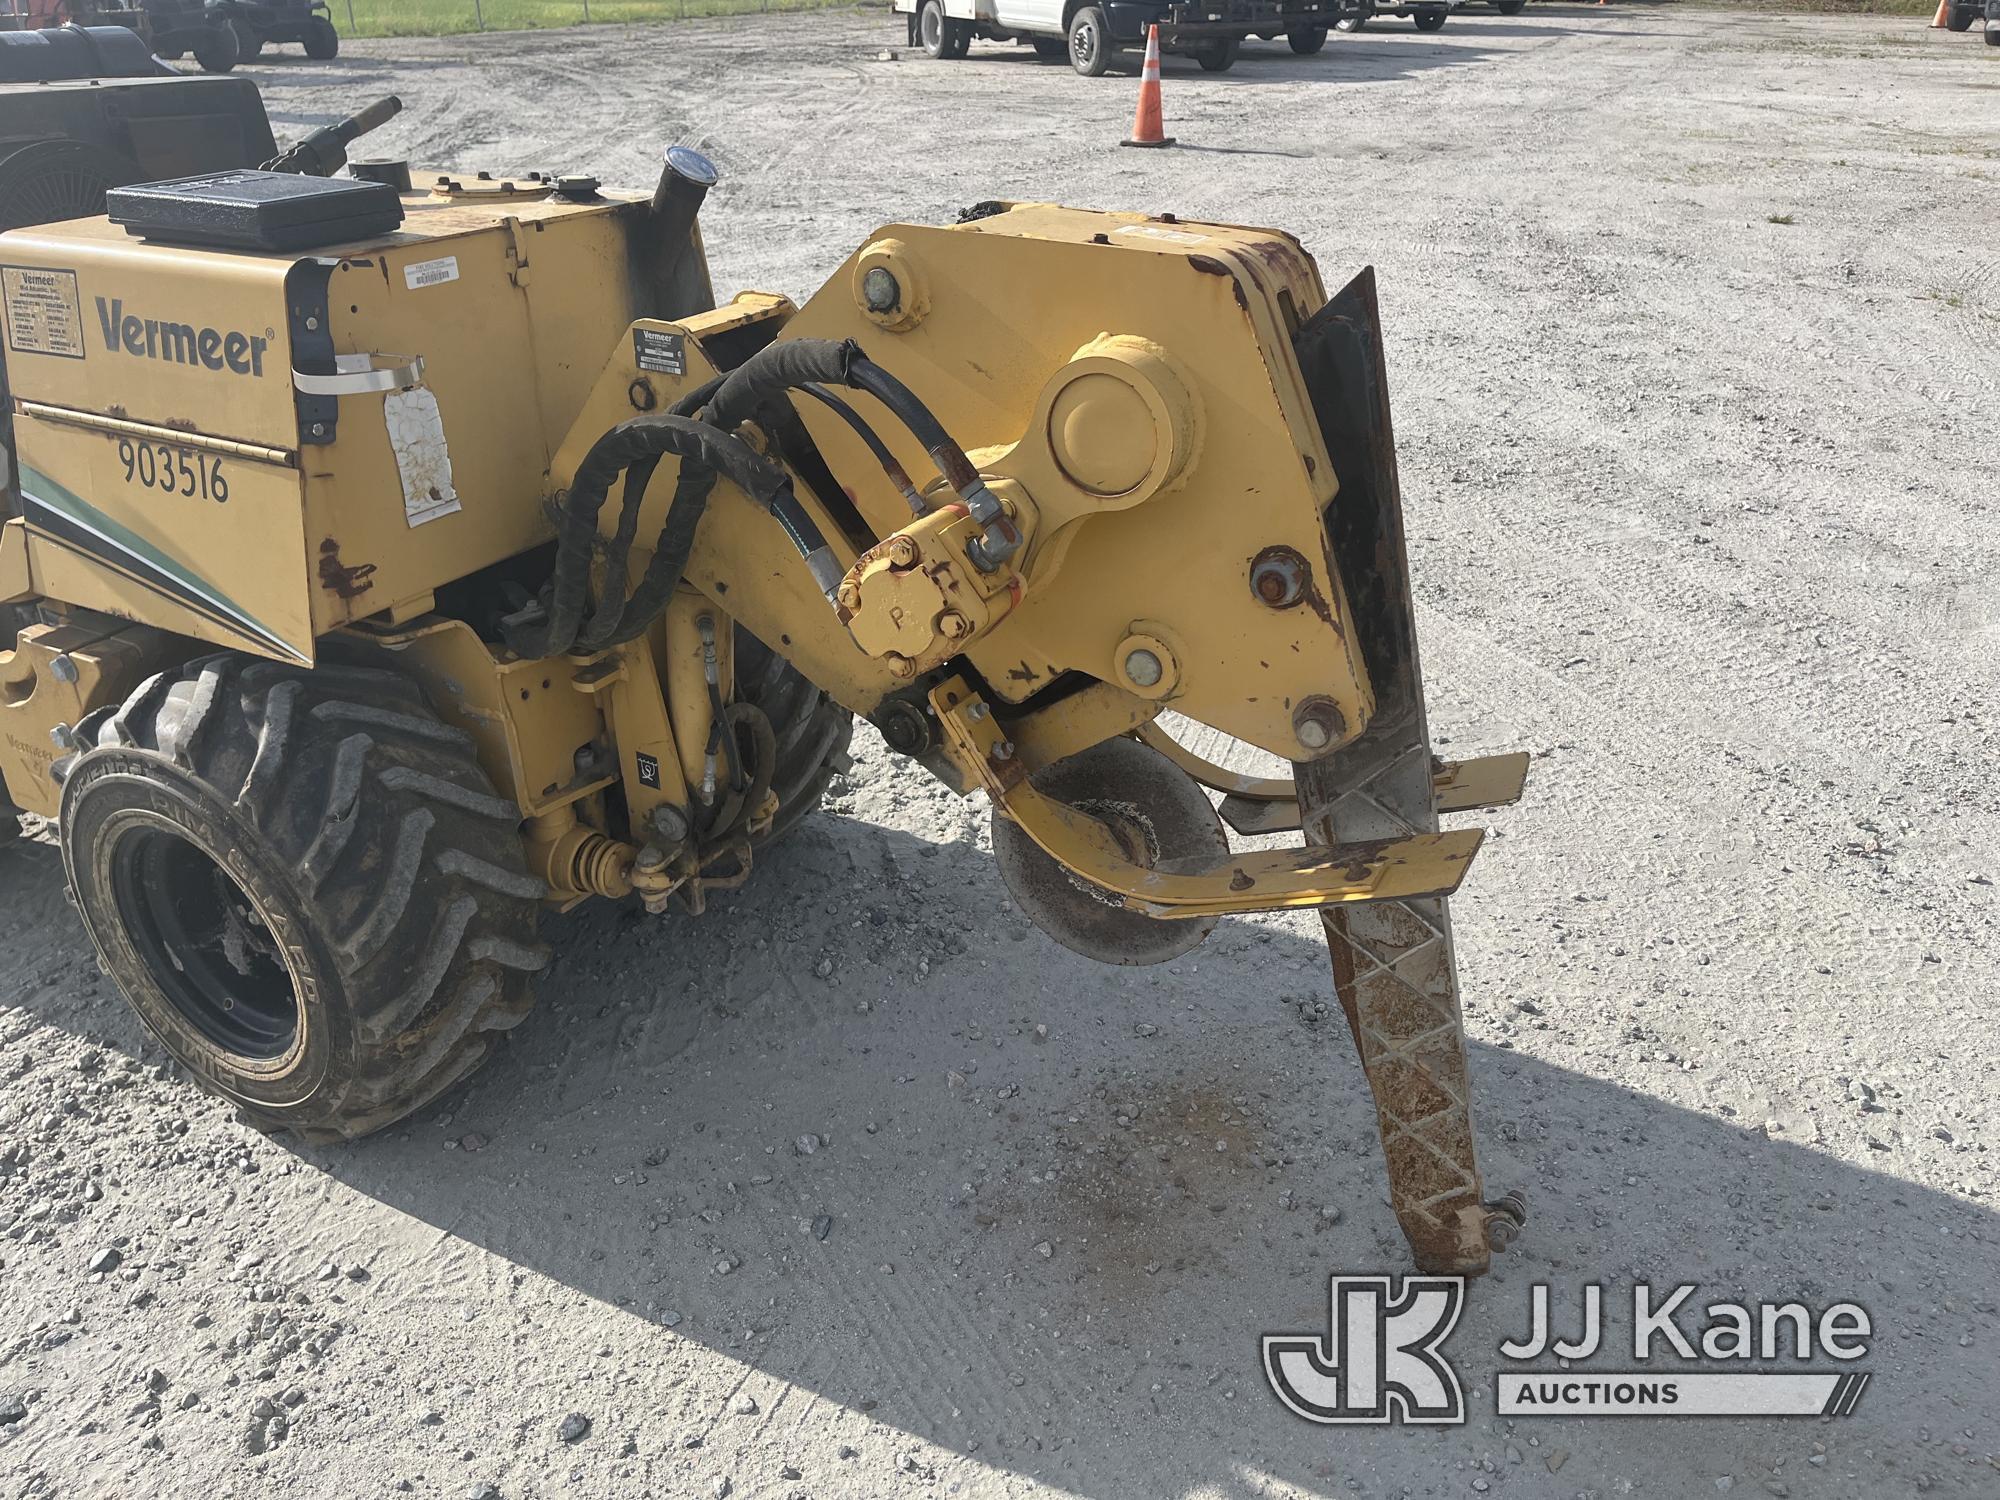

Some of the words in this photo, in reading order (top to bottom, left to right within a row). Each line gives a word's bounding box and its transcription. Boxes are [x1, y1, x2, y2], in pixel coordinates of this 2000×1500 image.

[22, 271, 55, 286] Vermeer
[643, 330, 672, 342] Vermeer
[118, 439, 229, 503] 903516
